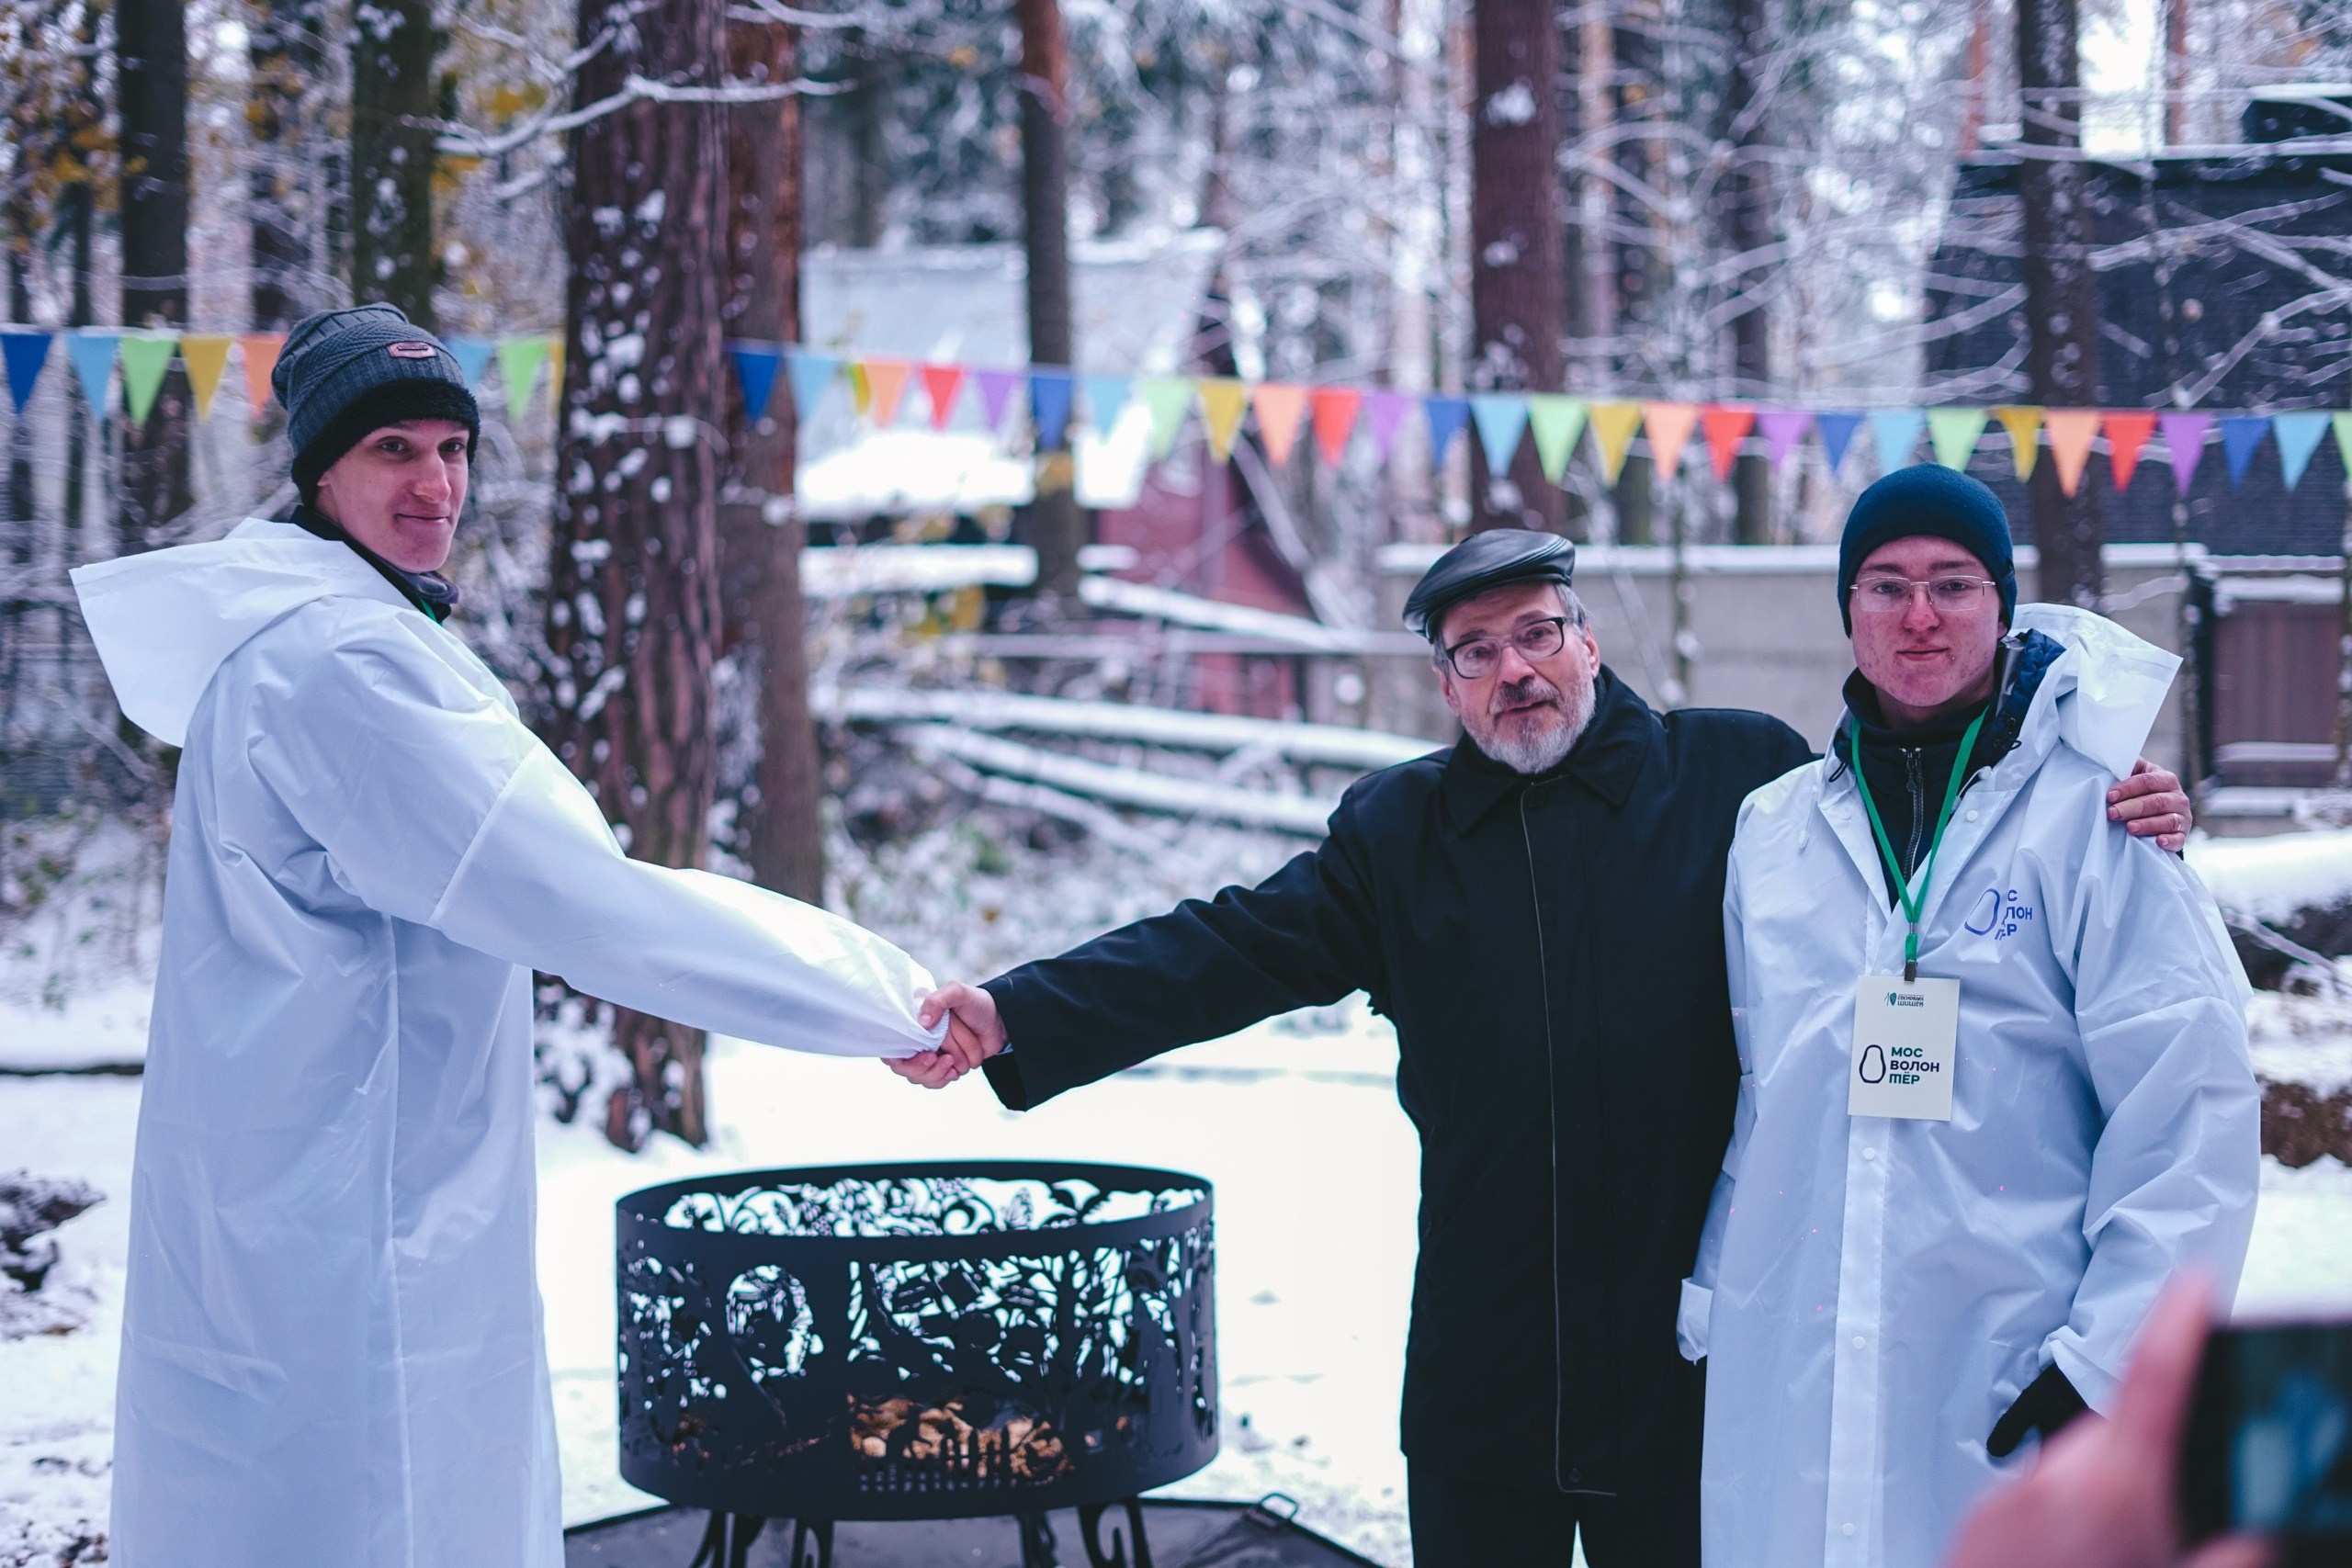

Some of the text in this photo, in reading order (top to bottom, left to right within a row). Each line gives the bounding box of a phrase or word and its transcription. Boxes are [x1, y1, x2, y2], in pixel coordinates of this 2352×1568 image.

[2002, 906, 2032, 921] ЛОН
[1891, 1046, 1923, 1057] МОС
[1890, 1060, 1939, 1072] ВОЛОН
